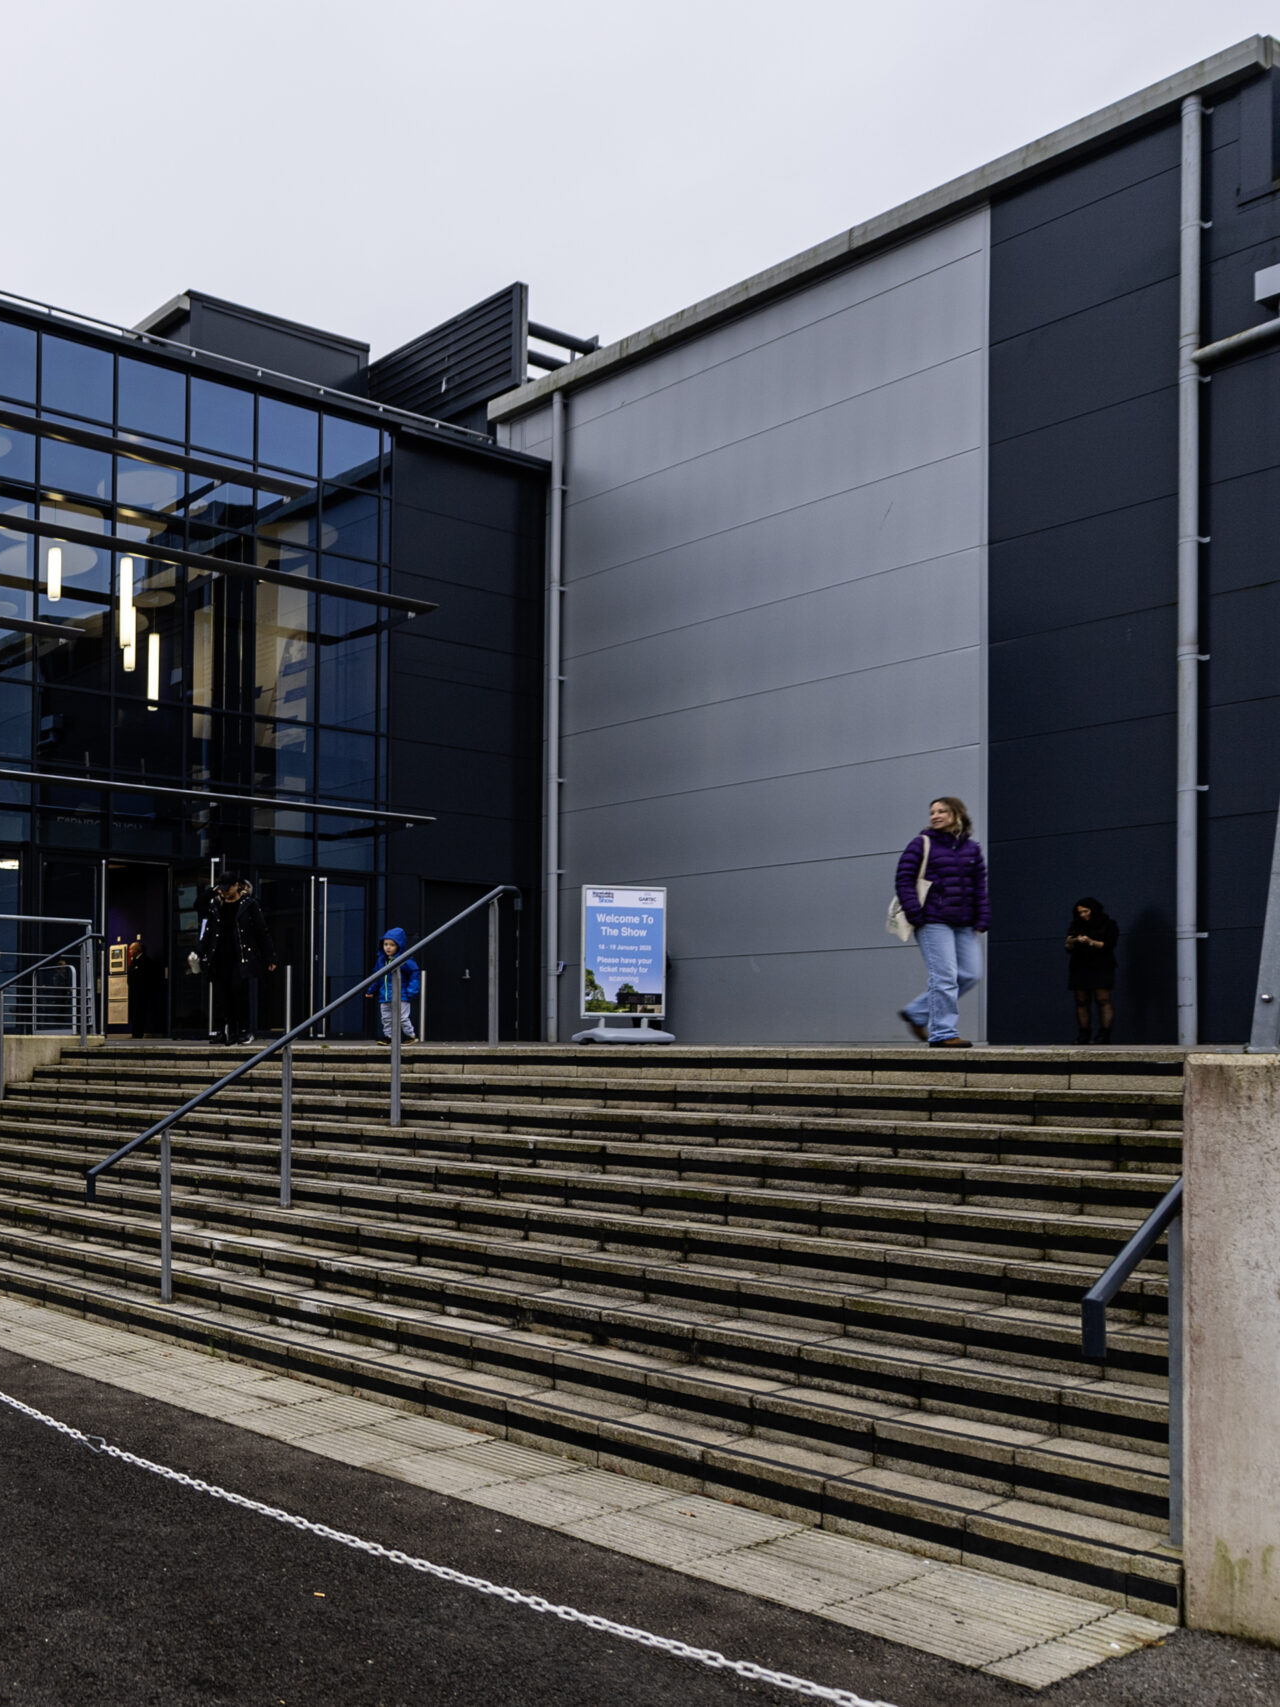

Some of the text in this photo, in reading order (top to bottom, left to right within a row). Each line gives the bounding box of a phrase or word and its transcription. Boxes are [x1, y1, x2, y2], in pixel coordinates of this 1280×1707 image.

[596, 913, 654, 924] Welcome To
[600, 926, 647, 936] The Show
[638, 958, 653, 966] your
[619, 966, 637, 975] ready
